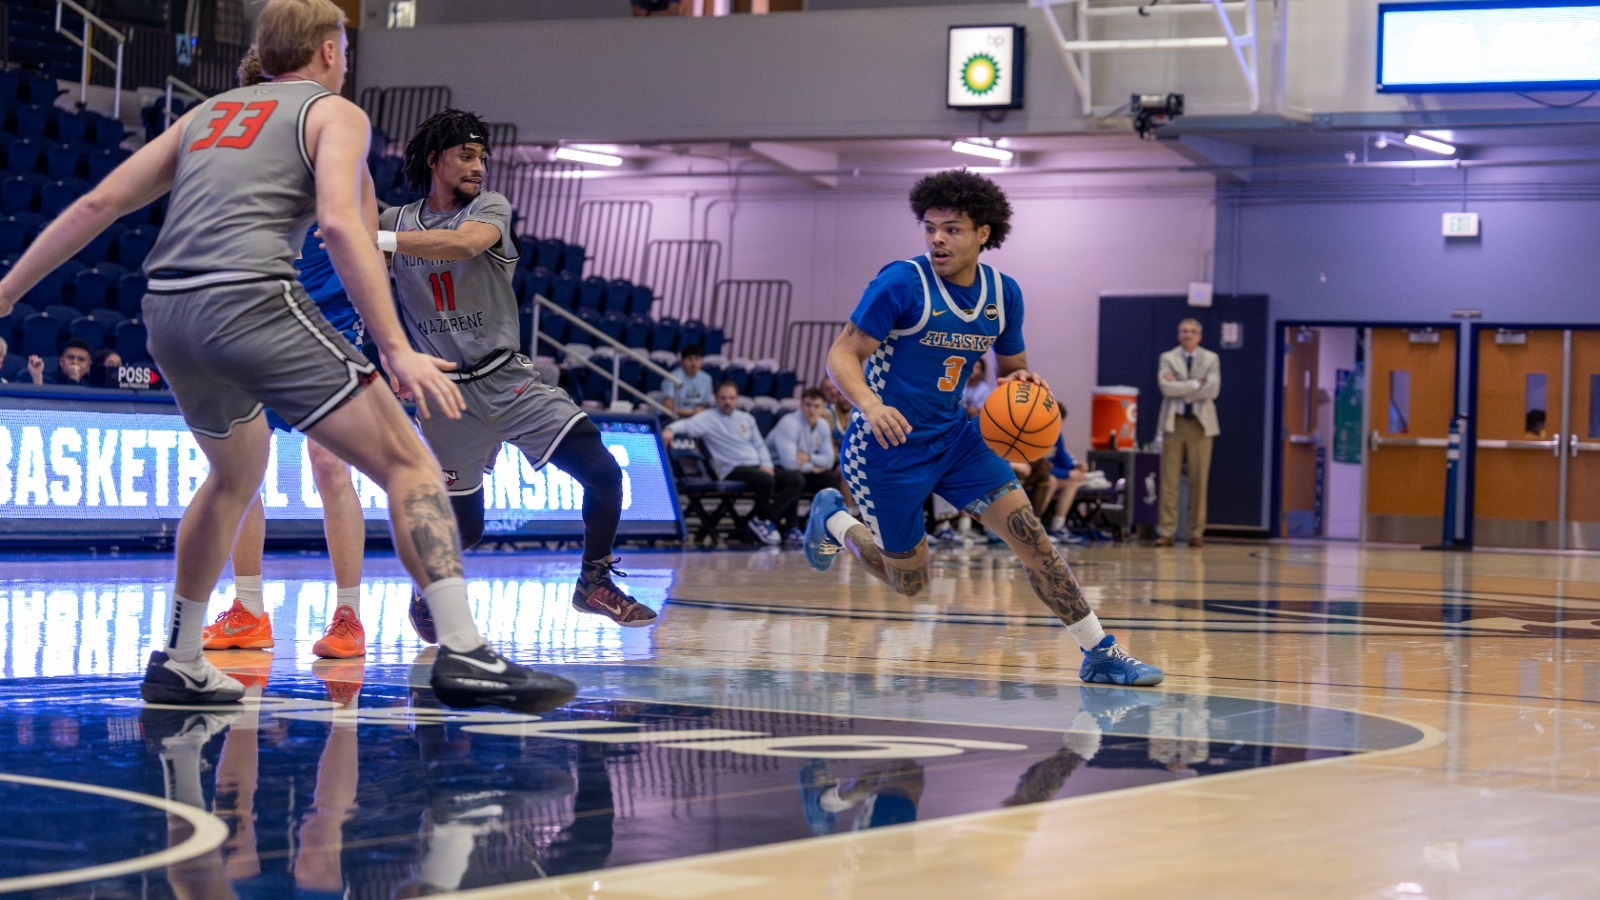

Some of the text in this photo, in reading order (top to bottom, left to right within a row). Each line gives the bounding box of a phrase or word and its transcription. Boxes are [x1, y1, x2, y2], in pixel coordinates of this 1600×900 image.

[986, 34, 1006, 48] bp
[189, 99, 278, 153] 33
[429, 270, 456, 312] 11
[418, 311, 485, 336] NAZARENE
[118, 366, 151, 383] POSS
[937, 355, 967, 392] 3
[0, 425, 288, 508] ASKETBL
